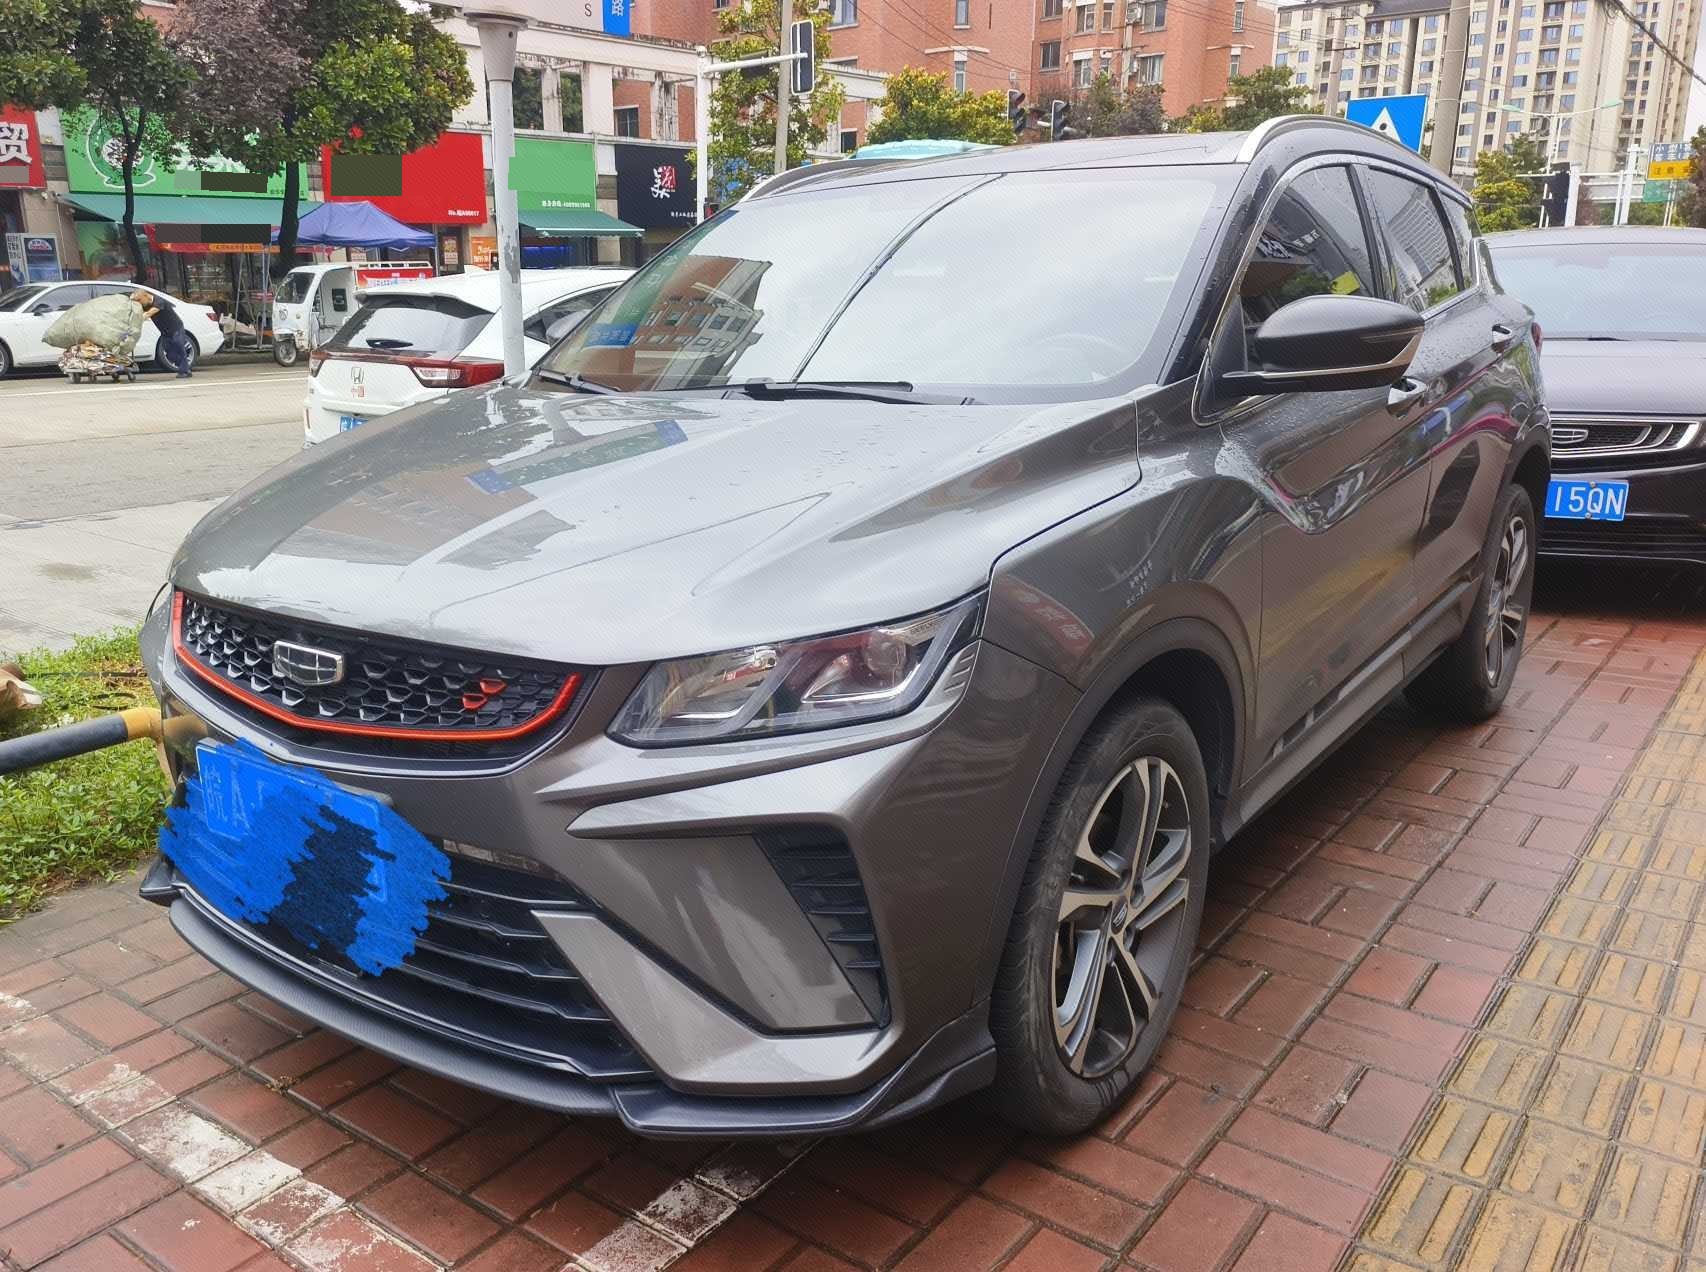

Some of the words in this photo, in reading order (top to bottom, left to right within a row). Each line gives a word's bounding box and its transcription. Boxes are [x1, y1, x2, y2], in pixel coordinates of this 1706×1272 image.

[584, 3, 592, 17] S
[0, 122, 33, 164] 贸
[1554, 486, 1624, 515] 15QN
